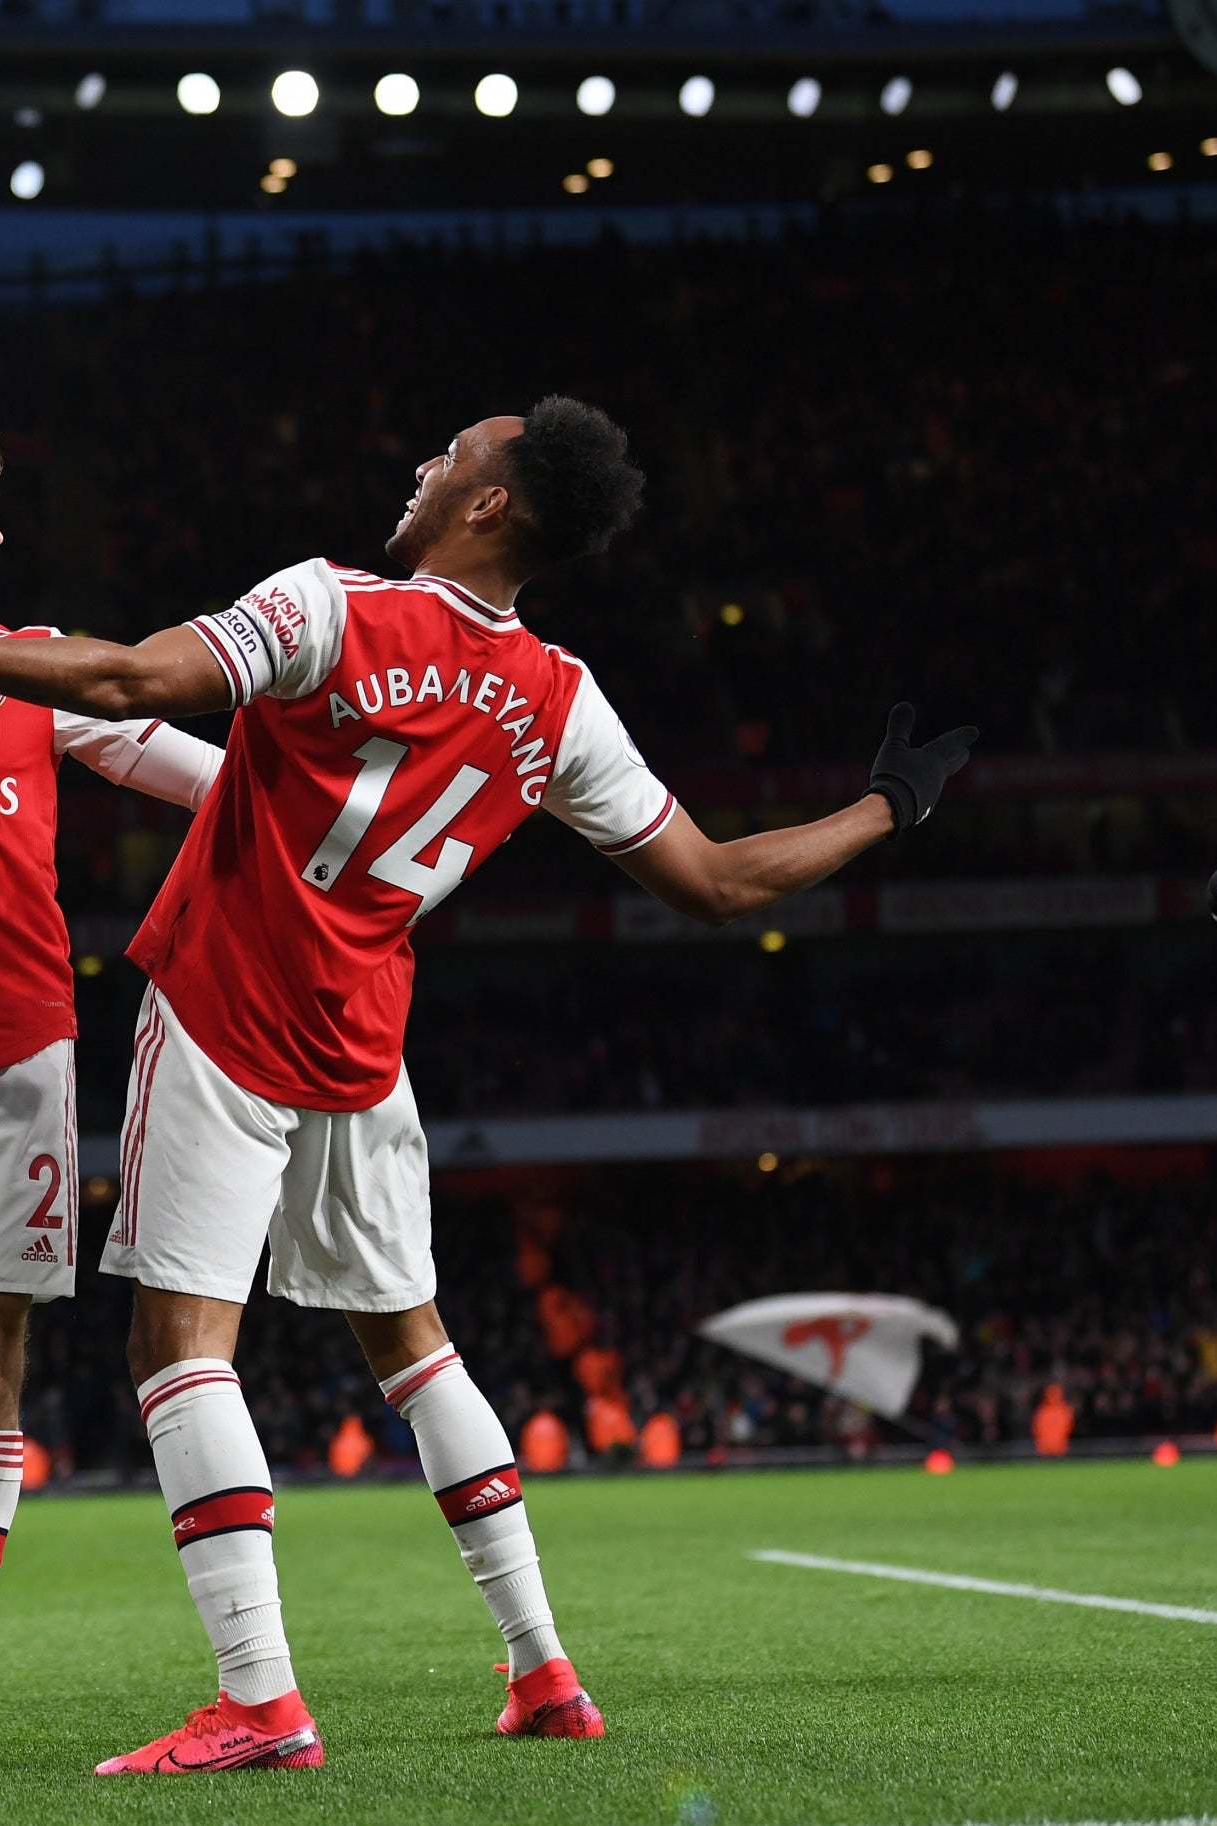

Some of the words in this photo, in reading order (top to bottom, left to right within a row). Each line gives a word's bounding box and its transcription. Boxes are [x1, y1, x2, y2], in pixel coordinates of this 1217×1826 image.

[269, 586, 306, 629] VISIT
[217, 611, 258, 654] ptain
[300, 735, 491, 928] 14
[25, 1153, 63, 1229] 2
[21, 1251, 59, 1263] adidas
[465, 1487, 516, 1511] adidas
